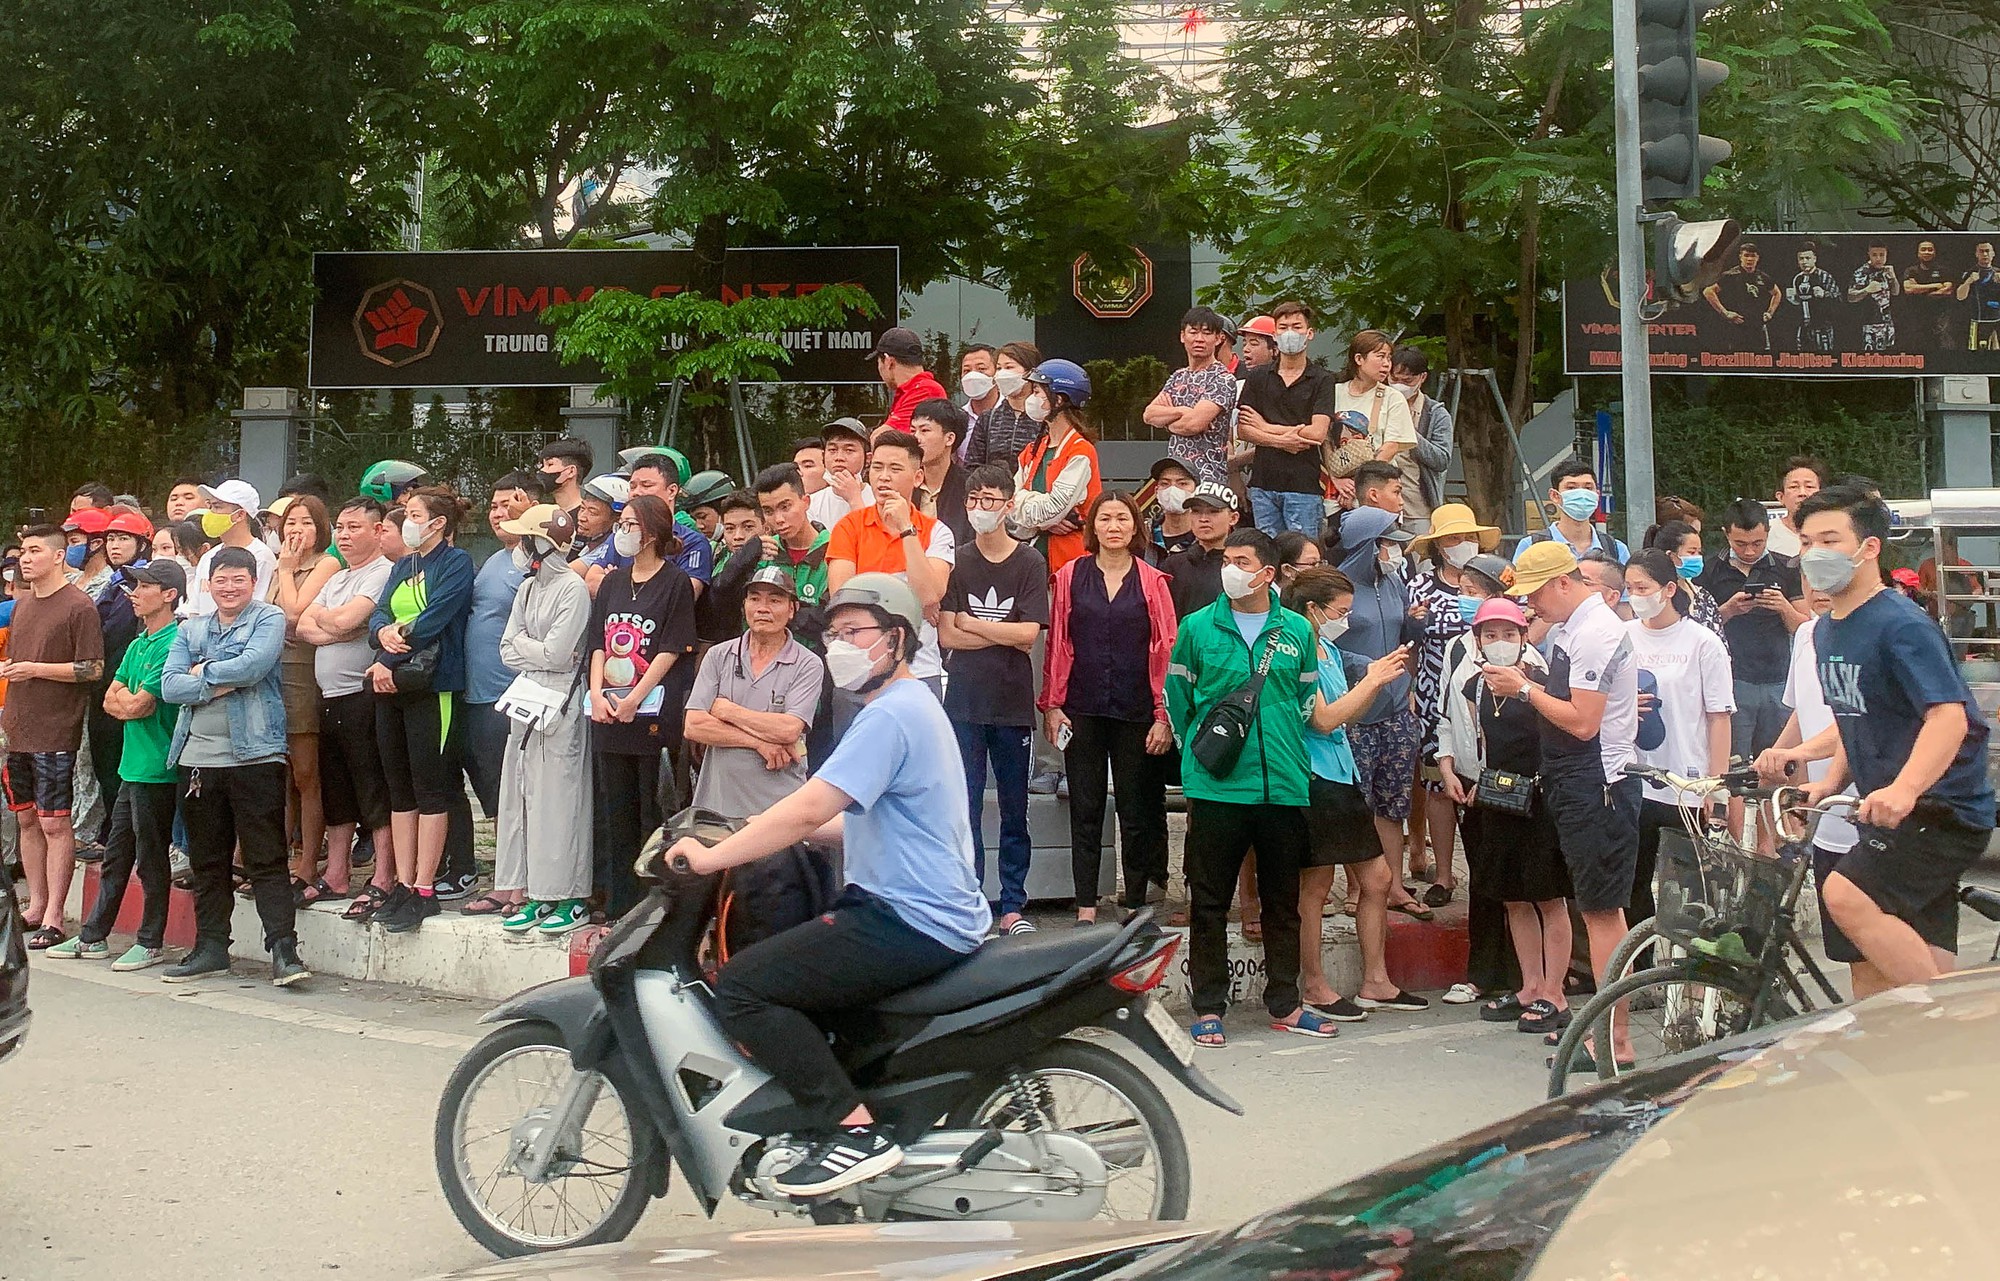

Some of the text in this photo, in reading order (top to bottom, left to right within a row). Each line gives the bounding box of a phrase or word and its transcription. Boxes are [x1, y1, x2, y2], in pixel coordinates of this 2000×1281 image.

[456, 283, 628, 317] VIMM
[1581, 323, 1698, 336] VIMM ENTER
[485, 333, 548, 353] TRUNG
[782, 328, 822, 352] VIỆT
[828, 331, 872, 350] NAM
[1649, 351, 1687, 368] oxing
[1841, 352, 1924, 369] Kickboxing
[1275, 643, 1299, 657] rab
